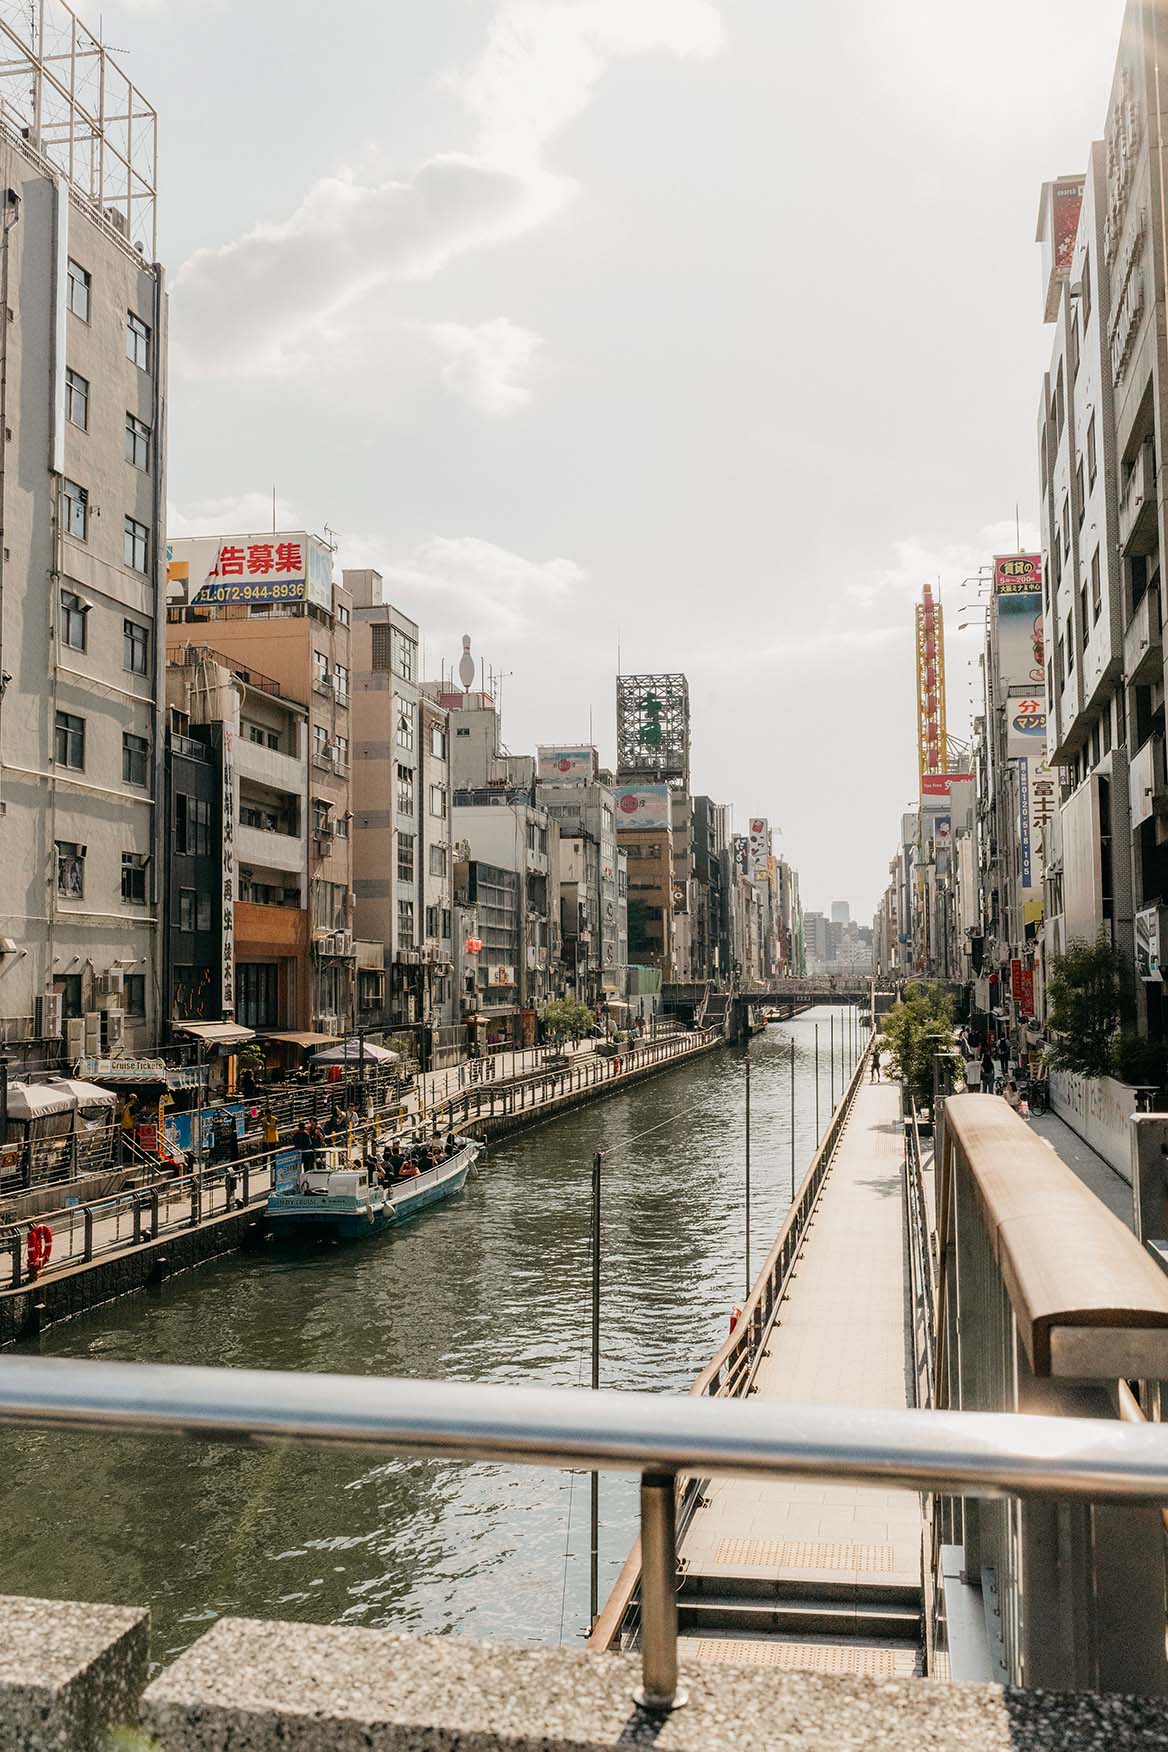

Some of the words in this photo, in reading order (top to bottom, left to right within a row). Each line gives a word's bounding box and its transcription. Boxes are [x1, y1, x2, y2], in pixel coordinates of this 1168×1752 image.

[209, 542, 302, 577] 告募集
[1018, 700, 1044, 713] 分
[111, 1061, 136, 1070] Cruise
[137, 1061, 163, 1070] Tickets
